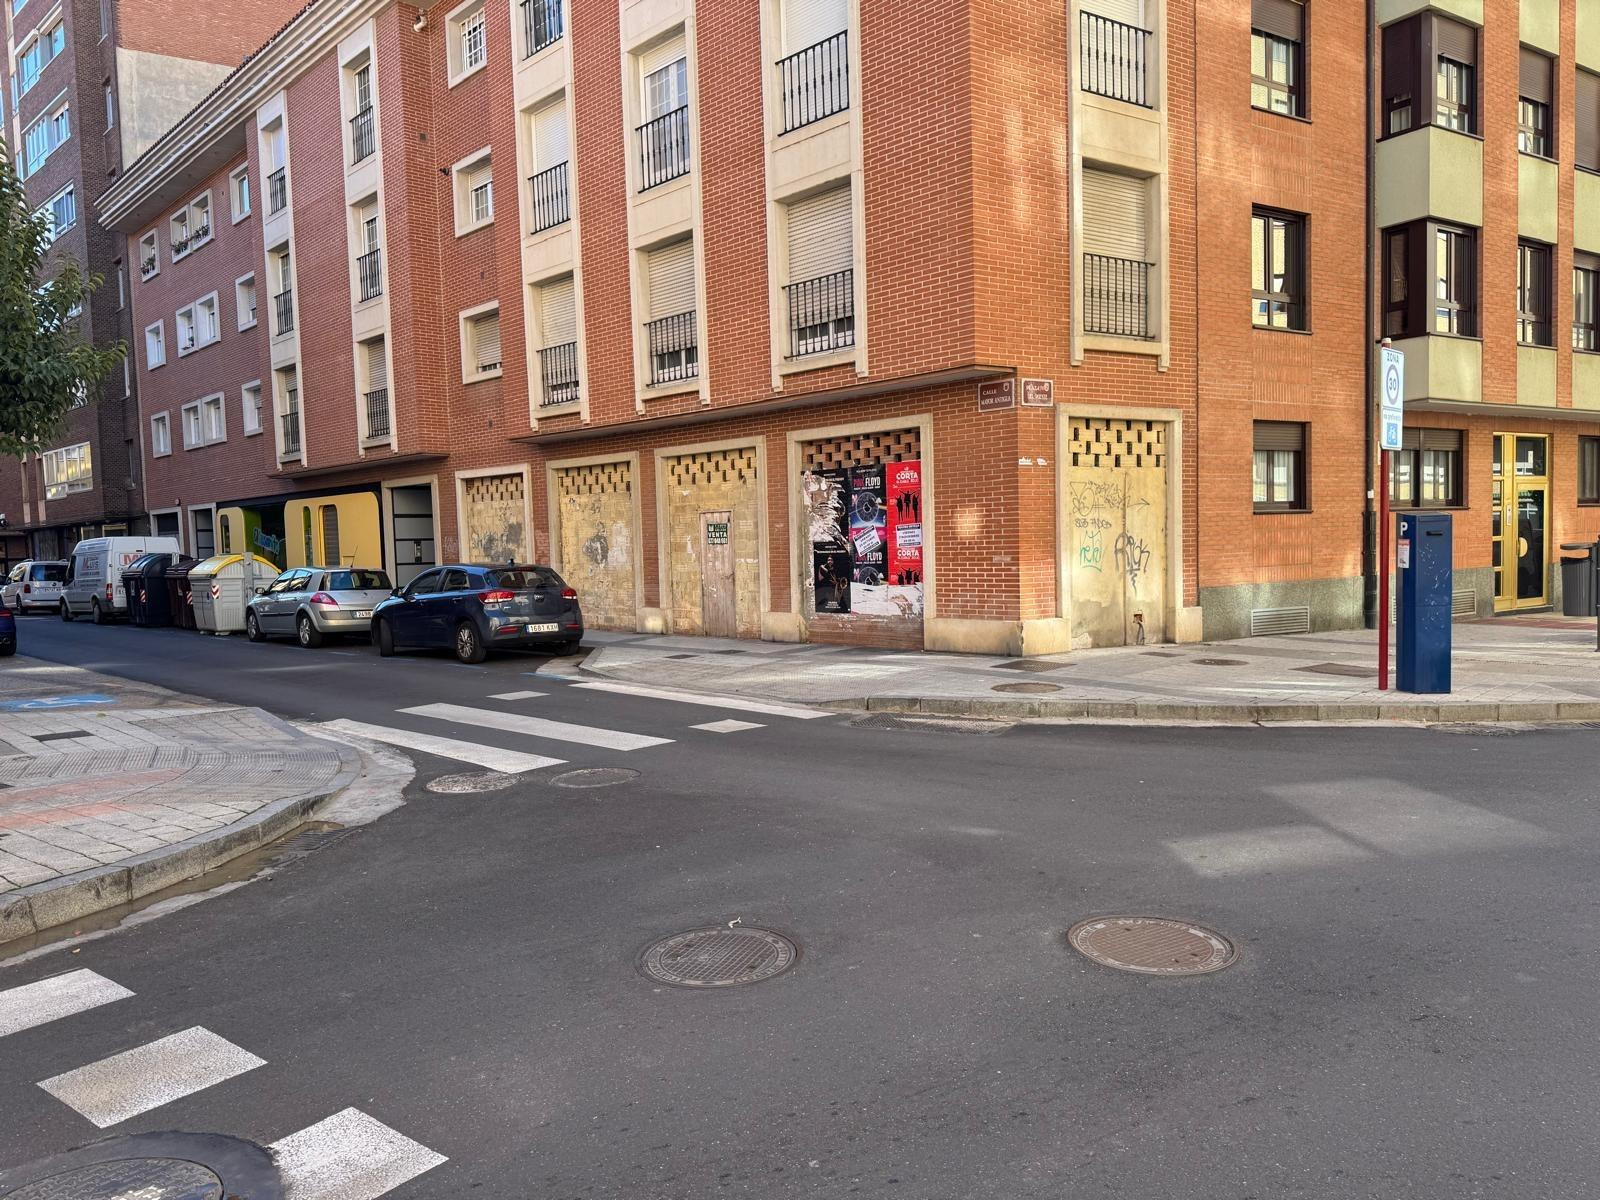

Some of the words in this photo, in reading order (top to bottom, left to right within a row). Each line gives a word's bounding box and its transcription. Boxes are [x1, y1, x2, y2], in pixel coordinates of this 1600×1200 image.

[1386, 352, 1399, 363] ZONA
[1389, 378, 1397, 391] 30
[982, 388, 997, 396] CALLE
[865, 476, 881, 487] FLOYD
[896, 472, 919, 480] CORTA
[1400, 521, 1408, 536] P
[867, 551, 883, 561] FLOYD
